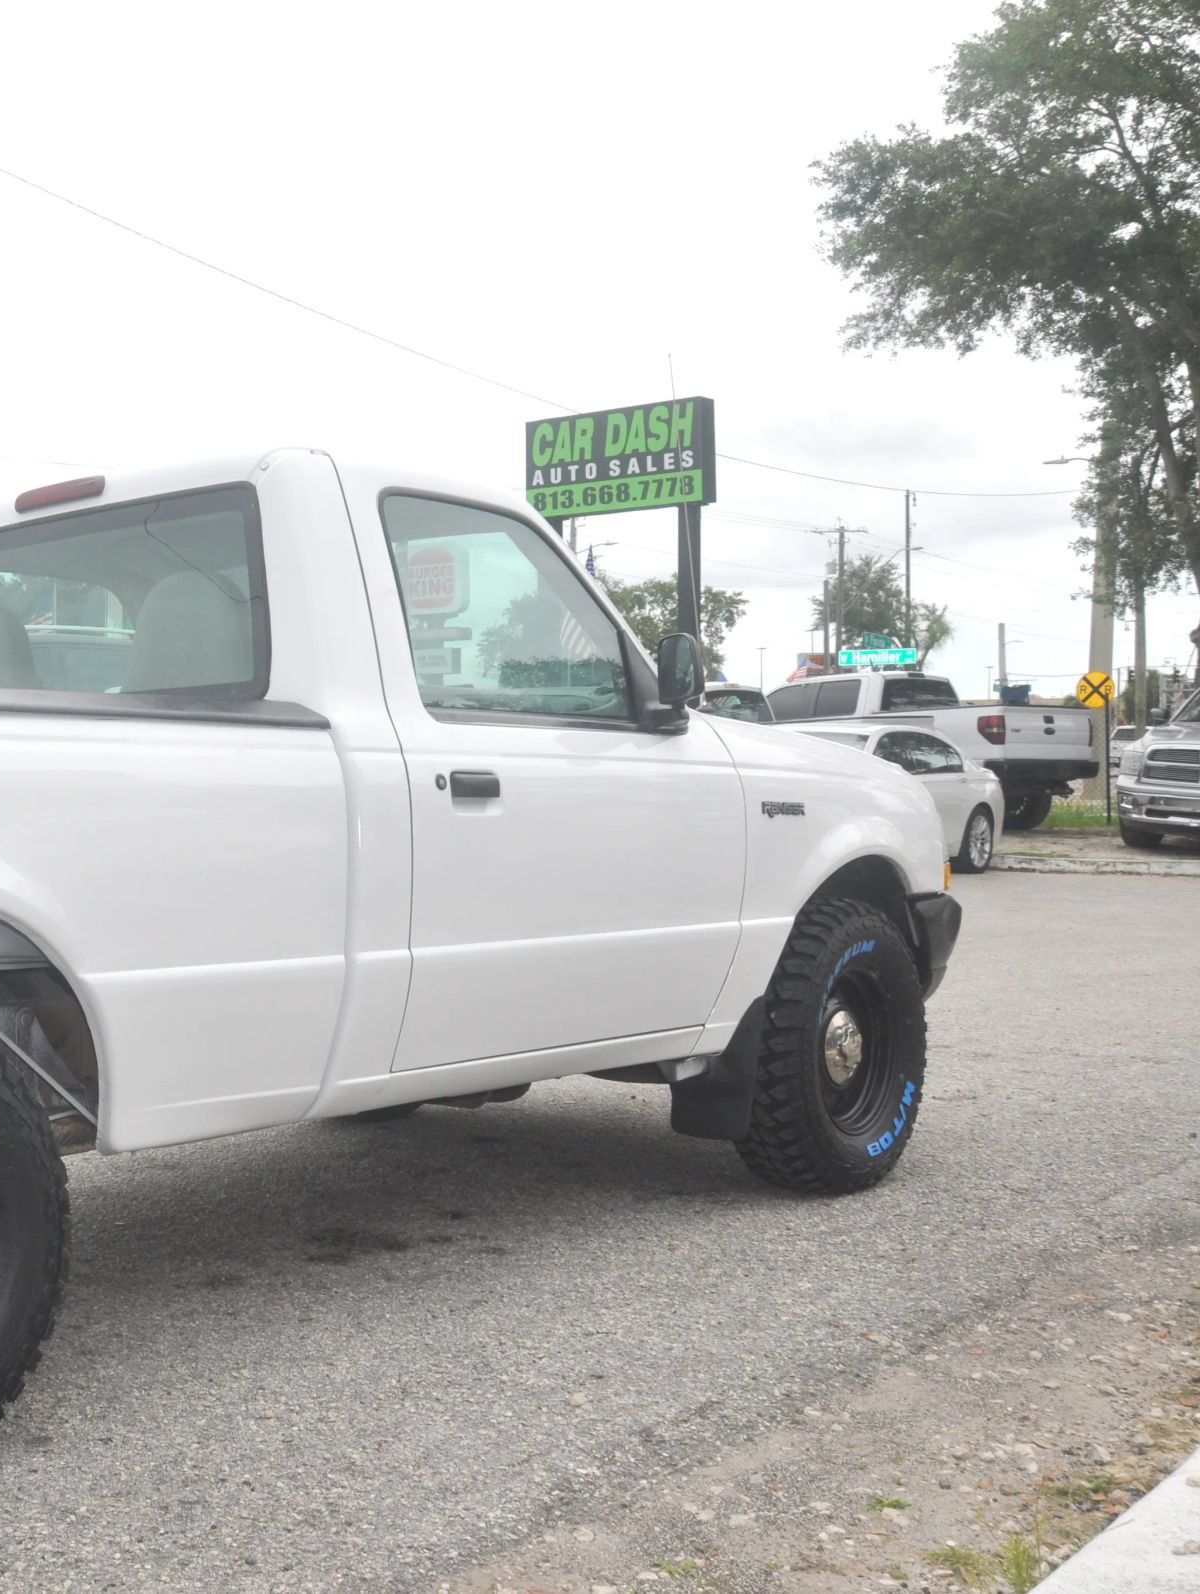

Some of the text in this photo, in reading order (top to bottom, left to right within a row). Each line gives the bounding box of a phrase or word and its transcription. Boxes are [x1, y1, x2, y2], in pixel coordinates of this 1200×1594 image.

[532, 401, 694, 467] CAR DASH
[532, 450, 694, 486] AUTO SALES
[533, 475, 695, 512] 813.668.7778
[408, 564, 455, 579] BURGER
[408, 578, 454, 598] KING
[1079, 684, 1112, 694] R R
